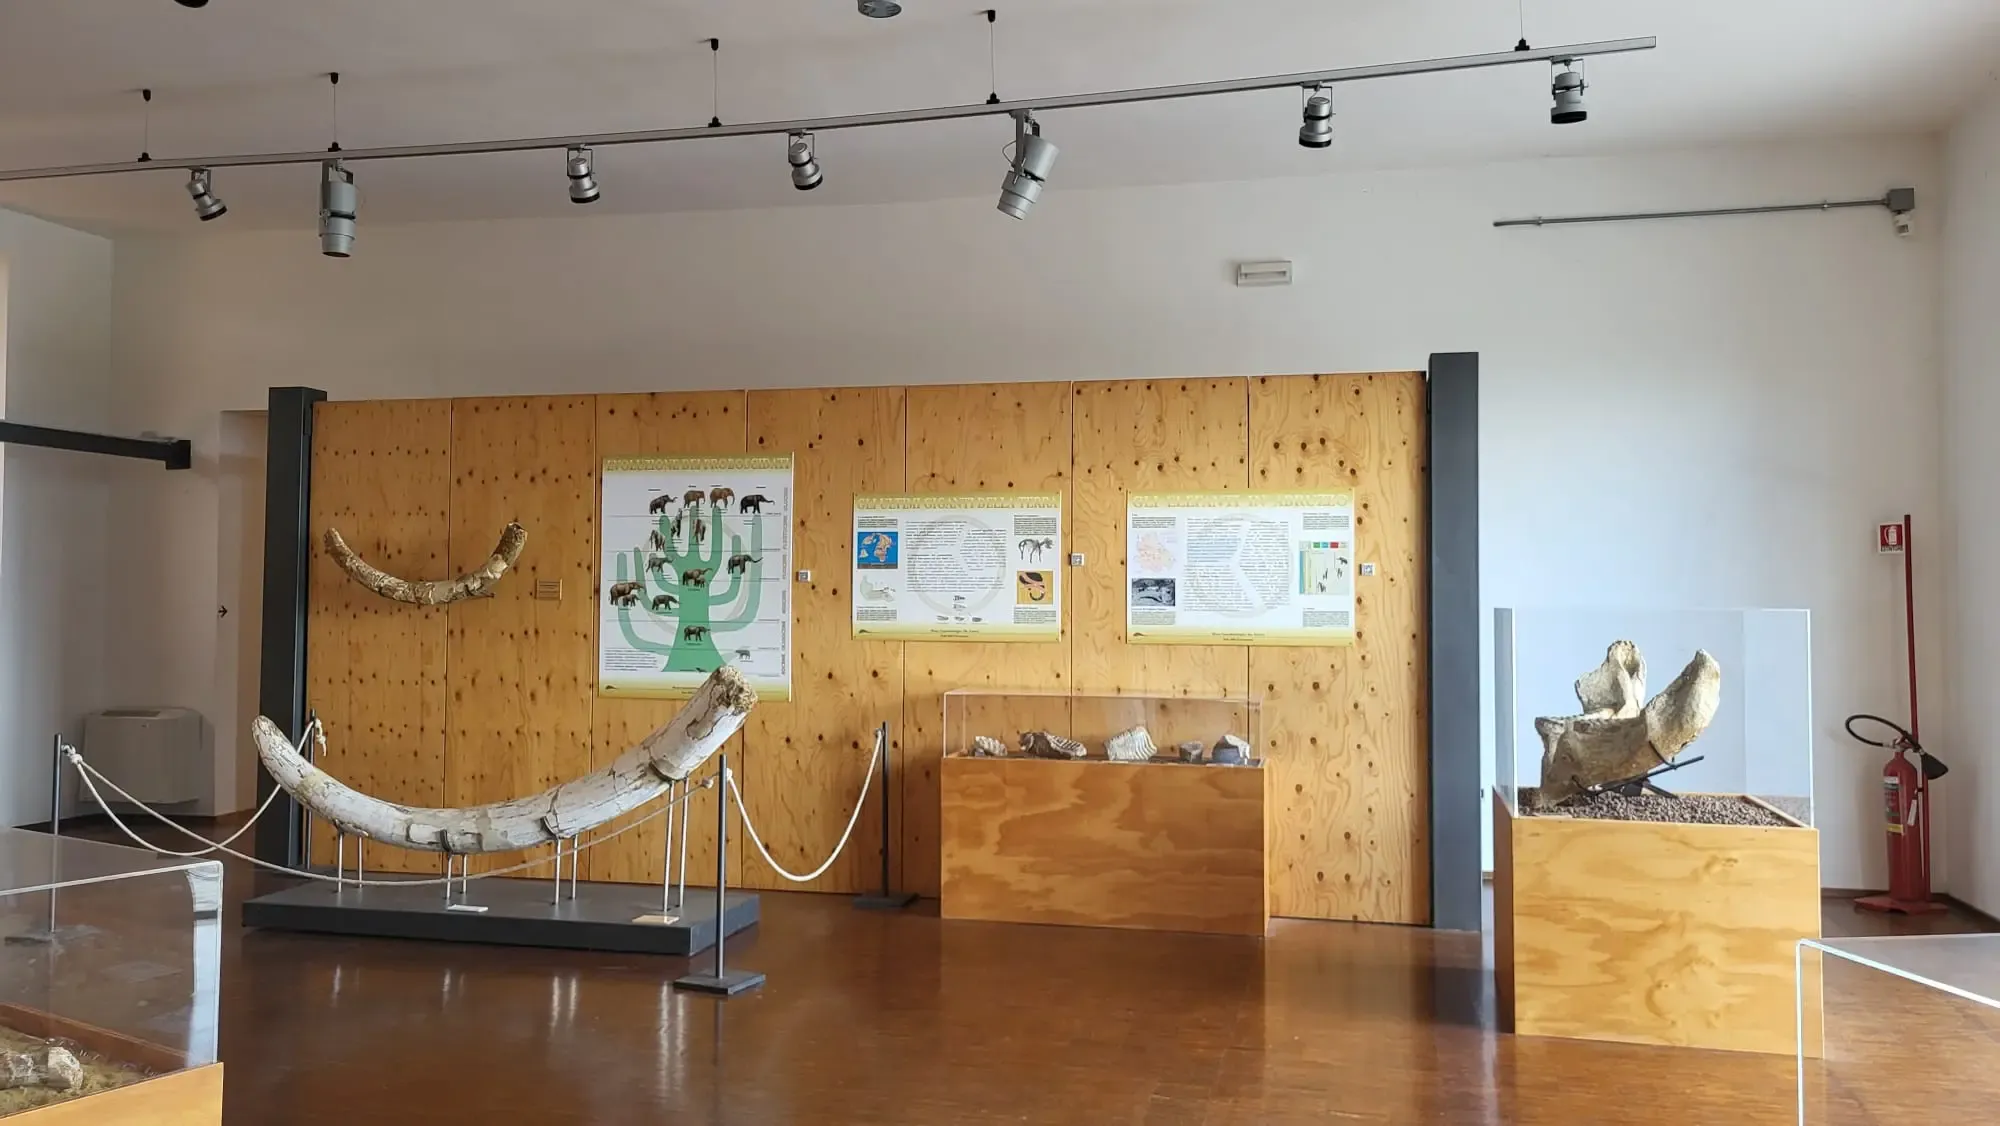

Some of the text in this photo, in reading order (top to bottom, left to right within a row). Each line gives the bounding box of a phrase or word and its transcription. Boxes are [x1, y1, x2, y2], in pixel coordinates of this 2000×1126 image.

[857, 496, 1058, 510] GLI ULTIMI GIGANTI DELLA TERRA
[1132, 494, 1348, 508] GLI ELEFANTI IN ABRUZZO
